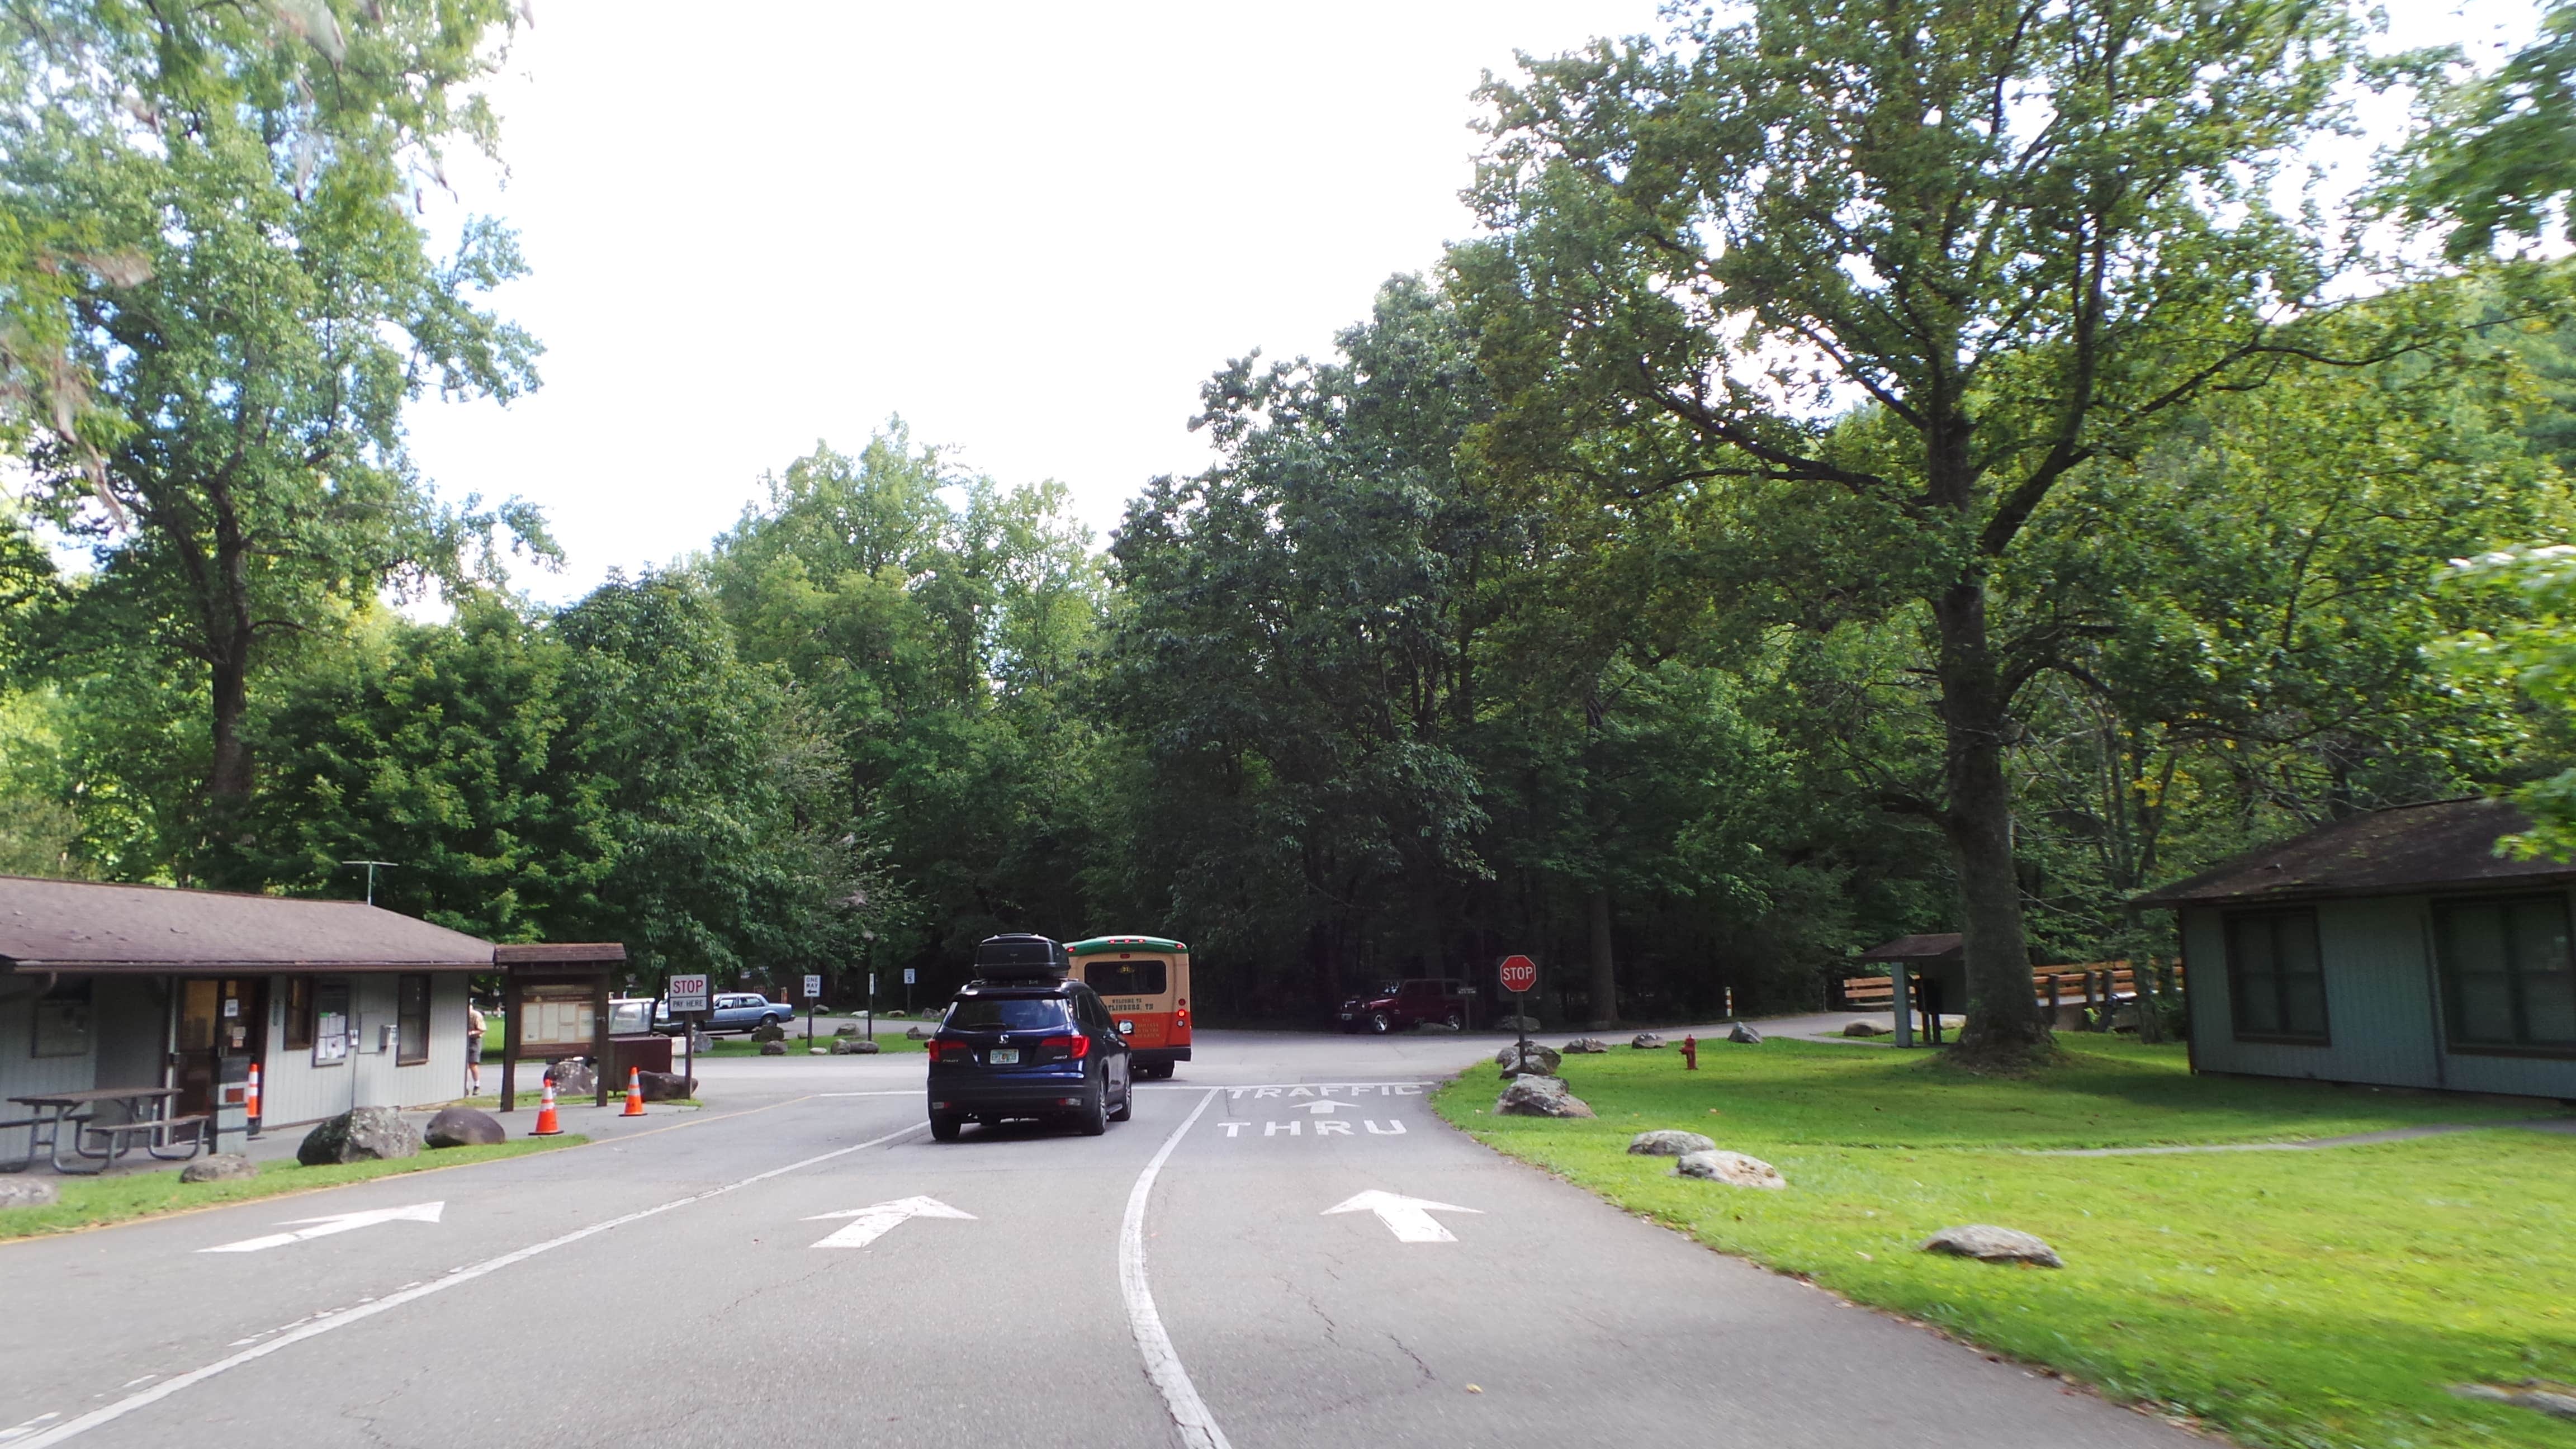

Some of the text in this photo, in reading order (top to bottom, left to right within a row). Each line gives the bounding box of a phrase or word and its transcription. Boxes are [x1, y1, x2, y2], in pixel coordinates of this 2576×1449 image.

[1503, 967, 1533, 981] STOP
[673, 980, 704, 994] STOP
[1228, 1085, 1423, 1099] TRAFFIC
[1217, 1119, 1408, 1137] THRU
